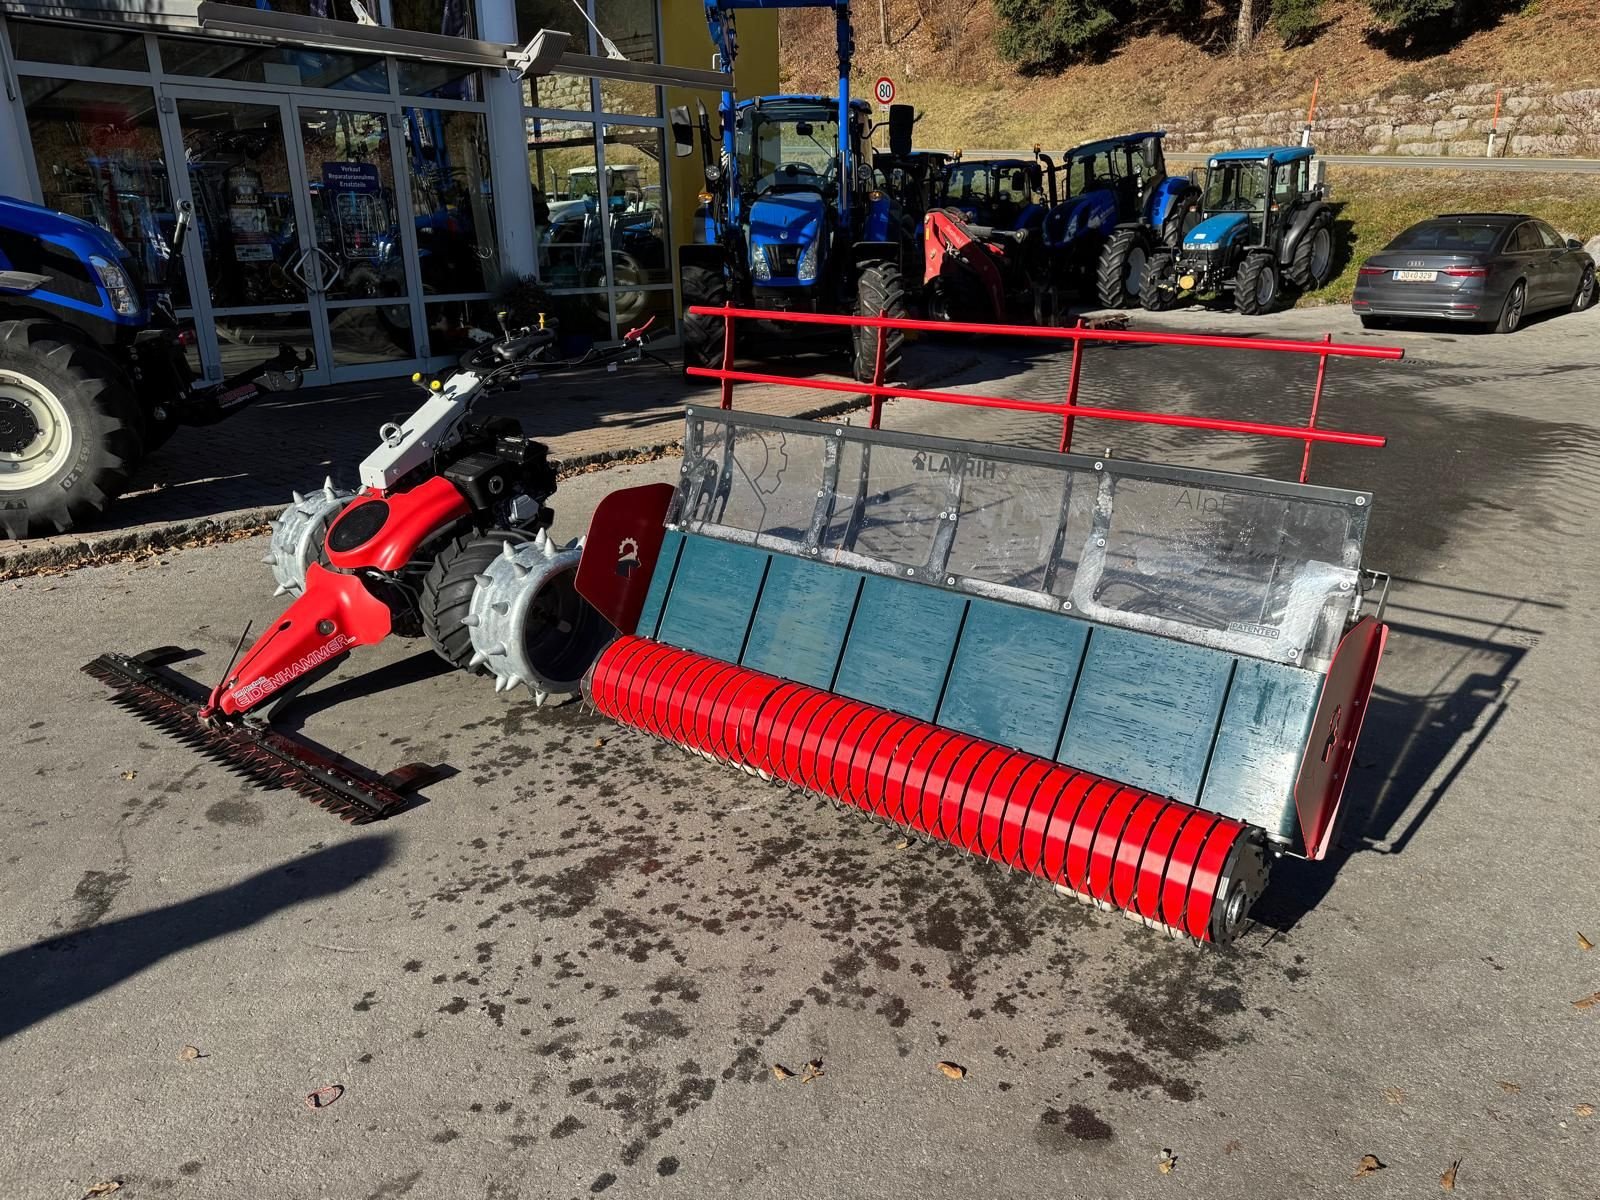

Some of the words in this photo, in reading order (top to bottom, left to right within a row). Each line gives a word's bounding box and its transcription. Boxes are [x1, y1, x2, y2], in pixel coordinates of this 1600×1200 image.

[880, 84, 891, 97] 80
[928, 455, 997, 479] LAVRIH
[1231, 622, 1279, 637] PATENTED
[234, 633, 350, 708] EIDENHAMMER
